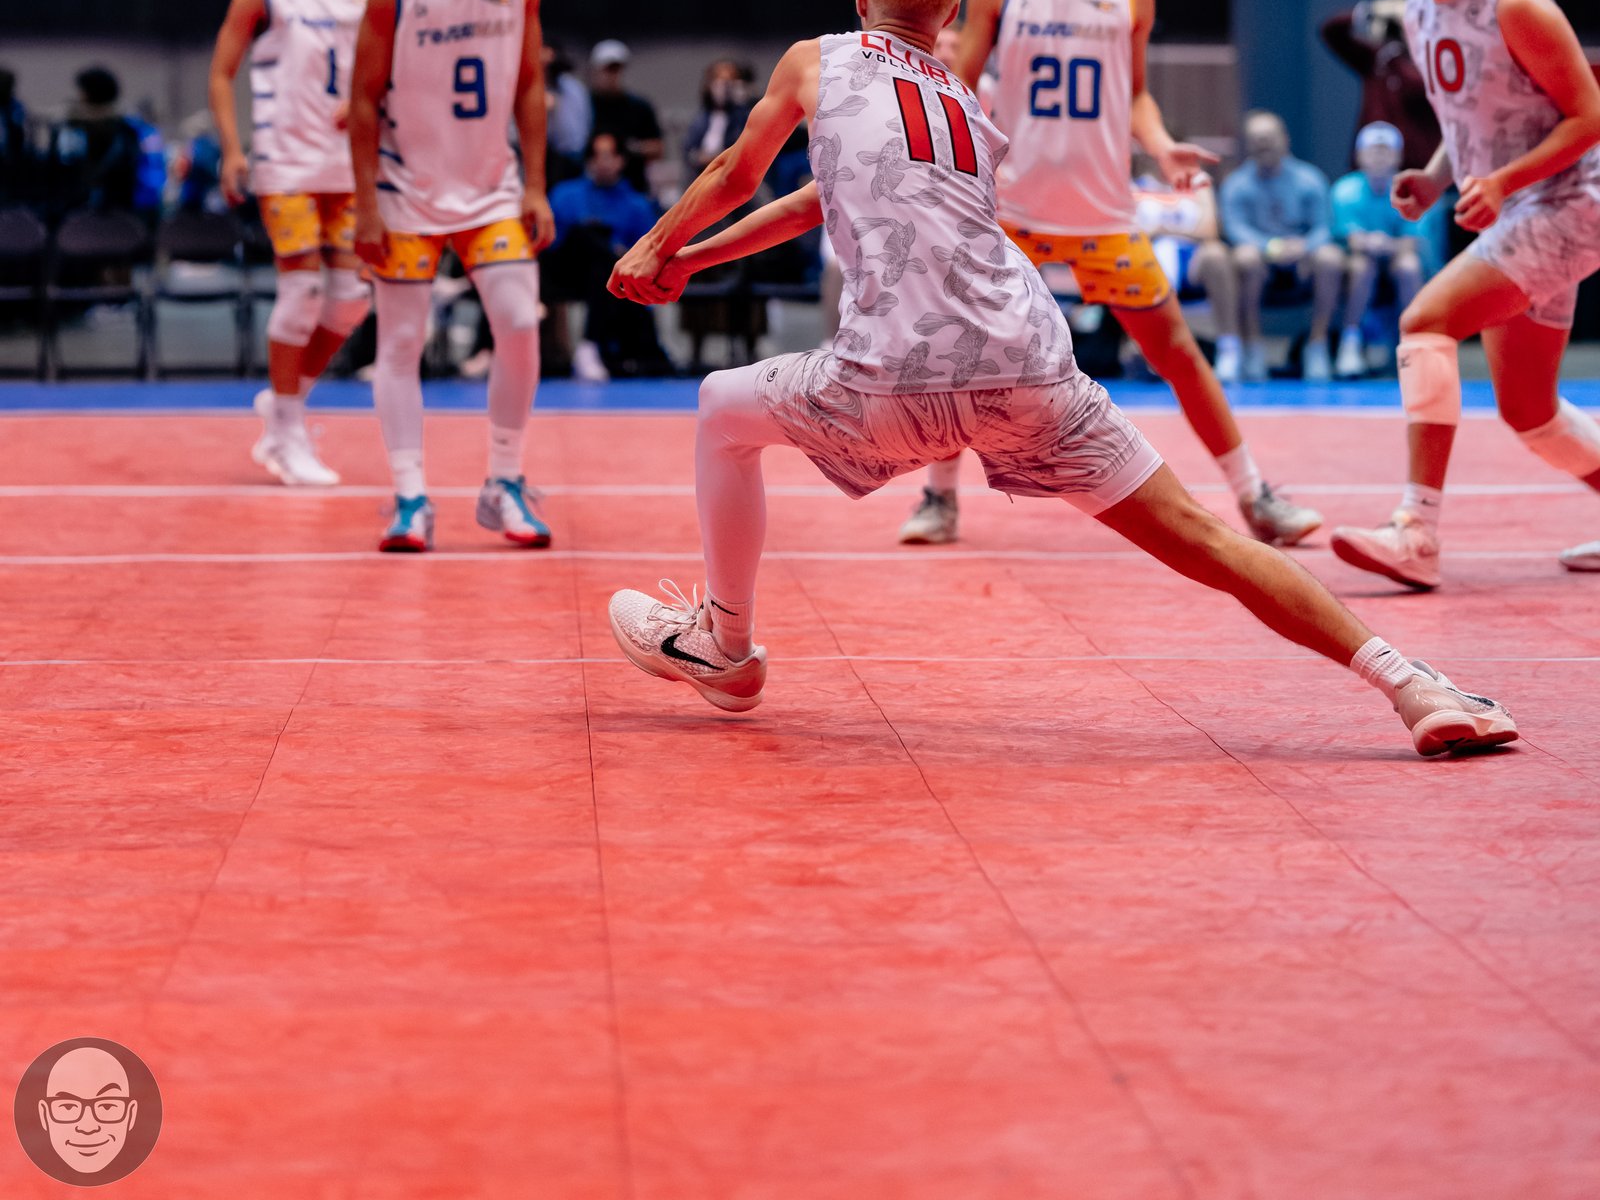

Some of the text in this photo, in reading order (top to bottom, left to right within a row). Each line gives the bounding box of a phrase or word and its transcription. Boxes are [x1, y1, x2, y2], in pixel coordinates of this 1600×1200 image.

[326, 48, 339, 95] 1
[453, 56, 488, 119] 9
[861, 33, 951, 86] CLUB
[1030, 56, 1102, 119] 20
[1425, 37, 1465, 95] 10
[892, 76, 979, 178] 11
